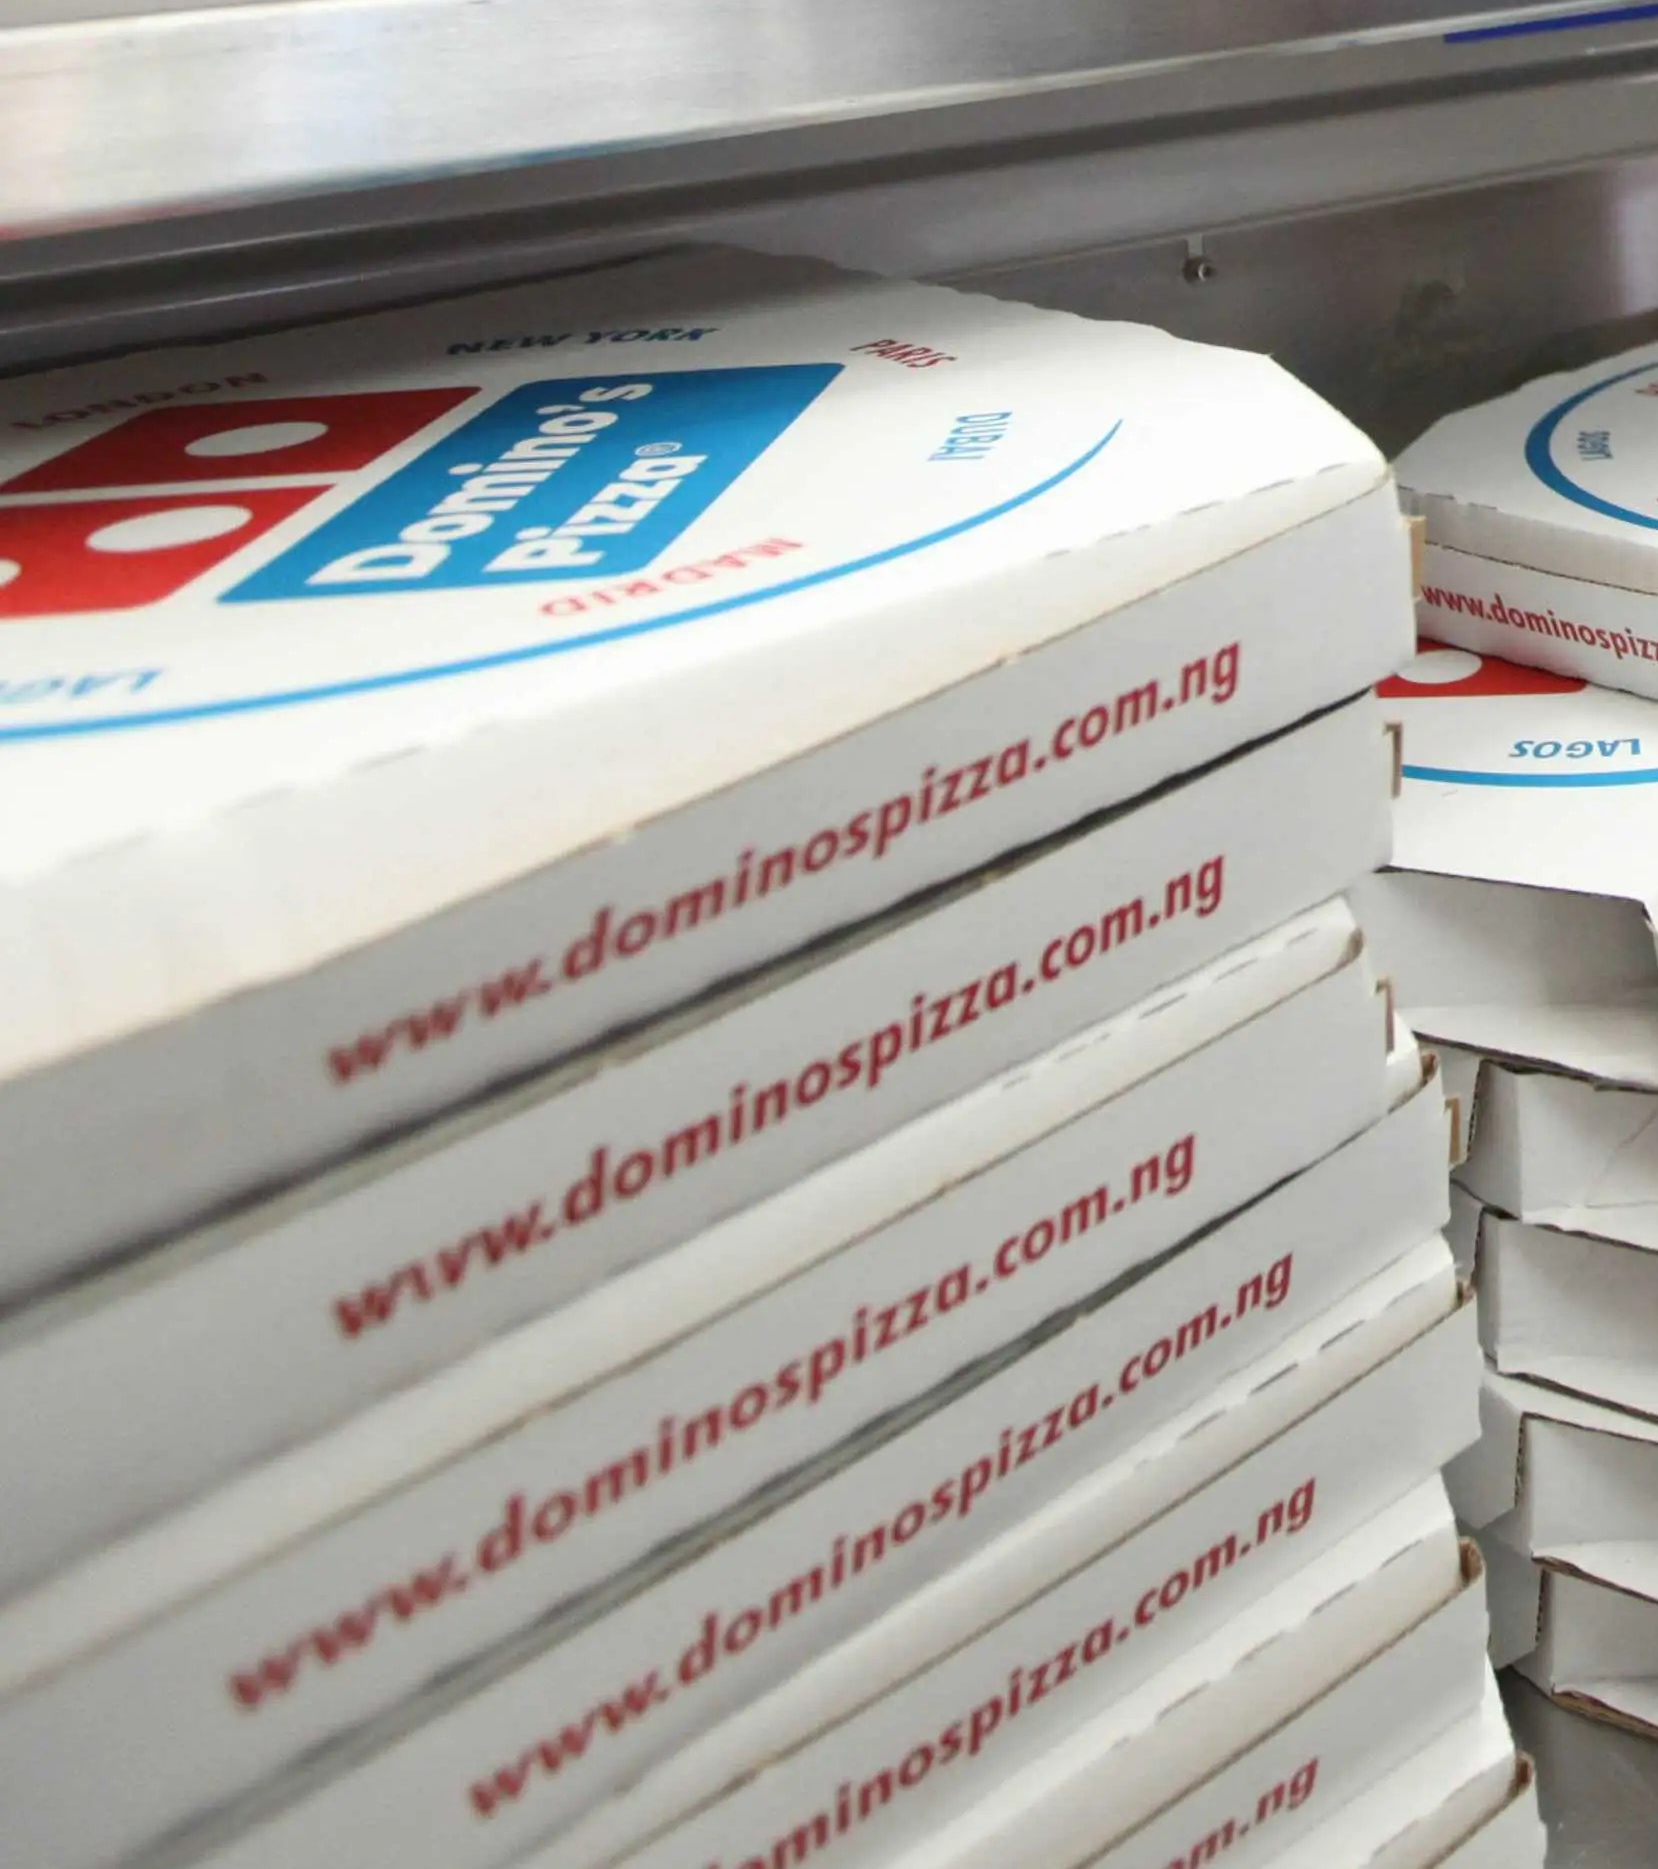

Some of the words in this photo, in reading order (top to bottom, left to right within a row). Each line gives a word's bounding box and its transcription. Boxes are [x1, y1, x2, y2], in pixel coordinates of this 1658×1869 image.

[445, 332, 564, 358] NEW
[584, 327, 722, 346] YORK
[848, 336, 962, 371] PARIS
[10, 372, 267, 430] LONDON
[924, 410, 1013, 464] DUBAI
[305, 382, 655, 586] Domino's
[535, 535, 808, 618] MADRID
[1508, 736, 1643, 760] LAGOS
[325, 638, 1244, 1087] www.dominospizza.com.ng
[330, 850, 1228, 1344] www.dominospizza.com.ng
[226, 1126, 1200, 1715] www.dominospizza.com.ng
[464, 1245, 1298, 1825] www.dominospizza.com.ng
